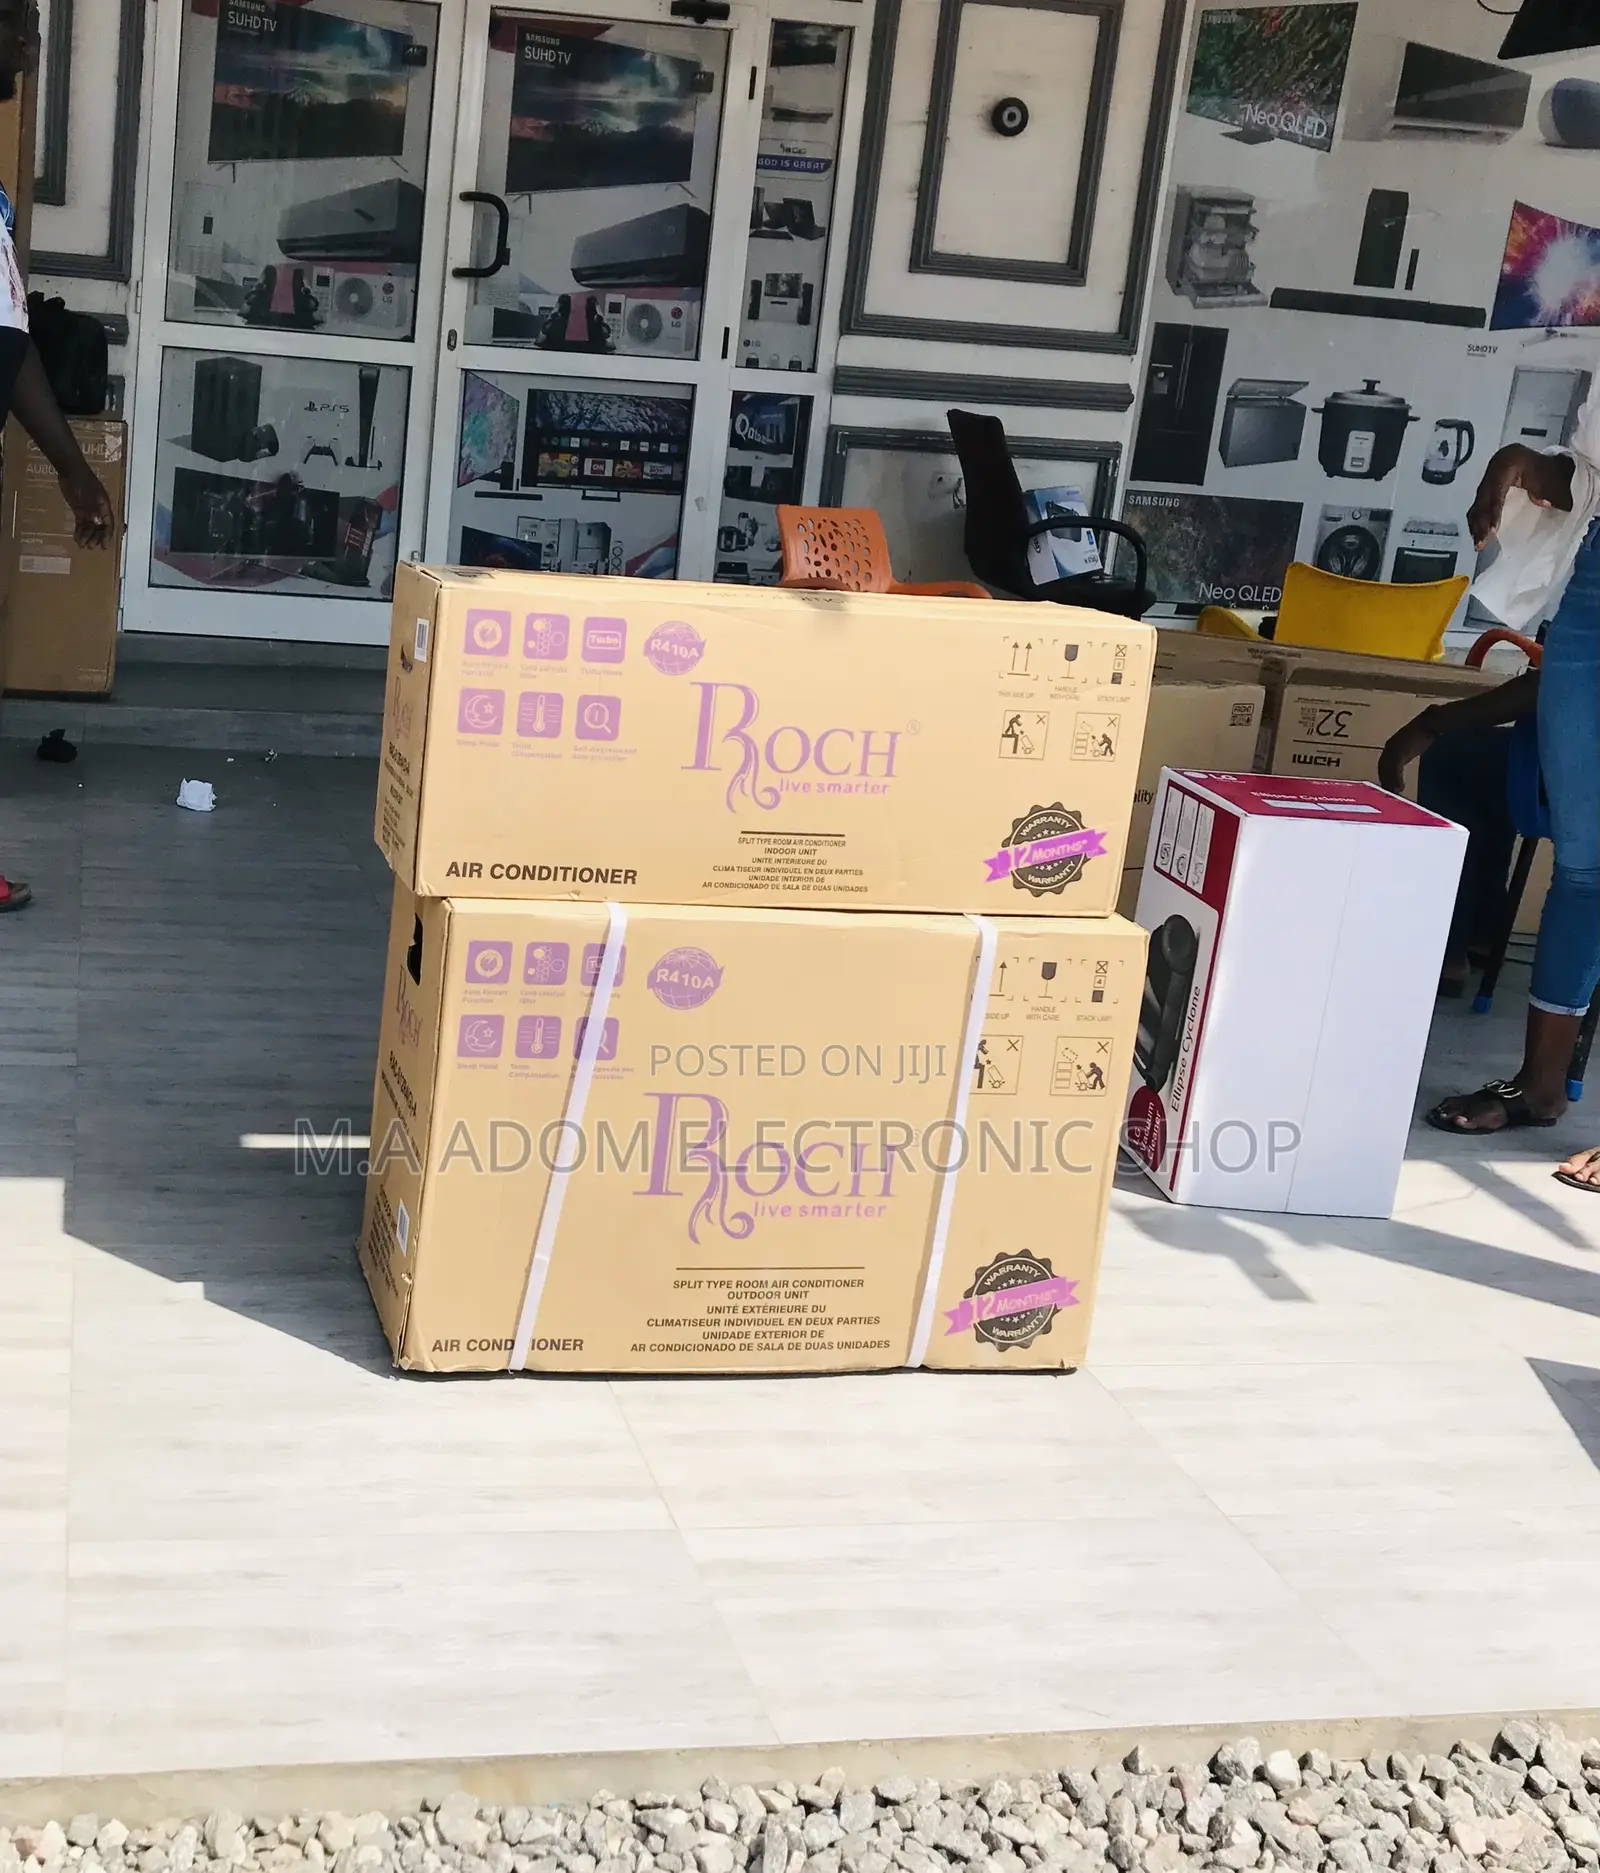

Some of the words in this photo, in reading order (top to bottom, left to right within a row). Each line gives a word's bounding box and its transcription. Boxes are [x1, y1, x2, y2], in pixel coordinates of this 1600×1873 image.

[526, 33, 560, 45] SAMSUNG
[1241, 103, 1277, 126] Neo
[1281, 111, 1327, 139] QLED
[793, 160, 826, 170] GREAT
[320, 403, 350, 413] PS5
[1129, 495, 1180, 507] SAMSUNG
[1199, 582, 1235, 599] Neo
[1239, 585, 1282, 602] QLED
[590, 634, 620, 645] Turbo
[651, 638, 699, 659] R410A
[681, 682, 902, 813] ROCH
[1292, 753, 1340, 768] HDMI
[780, 779, 811, 793] live
[816, 782, 890, 794] smarter
[1250, 791, 1297, 800] Ellipse
[1300, 795, 1356, 803] Cyclone
[1020, 816, 1073, 836] WARRANTY
[738, 837, 755, 845] SPLIT
[773, 838, 793, 846] ROOM
[804, 839, 846, 847] CONDITIONER
[764, 847, 797, 855] INDOOR
[798, 848, 817, 856] UNIT
[817, 858, 827, 866] DU
[446, 861, 483, 878] AIR
[490, 863, 637, 885] CONDITIONER
[781, 875, 815, 883] INTERIOR
[1028, 861, 1075, 885] WARRANTY
[714, 882, 769, 890] CONDICIONADO
[813, 884, 832, 892] DUAS
[656, 968, 714, 989] R410A
[1181, 985, 1201, 1053] Cyclone
[1171, 1057, 1186, 1113] Ellipse
[1140, 1101, 1155, 1152] Vacuum
[633, 1093, 898, 1245] ROCH
[754, 1202, 791, 1218] live
[798, 1204, 887, 1218] smarter
[984, 1264, 1041, 1286] WARRANTY
[673, 1280, 704, 1289] SPLIT
[706, 1280, 733, 1289] TYPE
[735, 1280, 768, 1288] ROOM
[771, 1280, 789, 1288] AIR
[792, 1279, 865, 1288] CONDITIONER
[727, 1291, 781, 1300] OUTDOOR
[784, 1290, 810, 1299] UNIT
[706, 1303, 739, 1314] UNITÉ
[742, 1302, 808, 1314] EXTÉRIEURE
[811, 1304, 827, 1313] DU
[646, 1318, 721, 1327] CLIMATISEUR
[723, 1317, 784, 1327] INDIVIDUEL
[787, 1317, 802, 1326] EN
[805, 1317, 834, 1326] DEUX
[836, 1316, 881, 1325] PARTIES
[992, 1312, 1045, 1337] WARRANTY
[702, 1331, 752, 1340] UNIDADE
[754, 1330, 808, 1339] EXTERIOR
[810, 1329, 825, 1338] DE
[432, 1339, 461, 1352] AIR
[466, 1338, 584, 1352] CONDIONER
[630, 1343, 646, 1352] AR
[649, 1343, 736, 1352] CONDICIONADO
[739, 1342, 754, 1351] DE
[756, 1342, 784, 1351] SALA
[787, 1342, 802, 1351] DE
[804, 1341, 834, 1350] DUAS
[837, 1340, 891, 1350] UNIDADES
